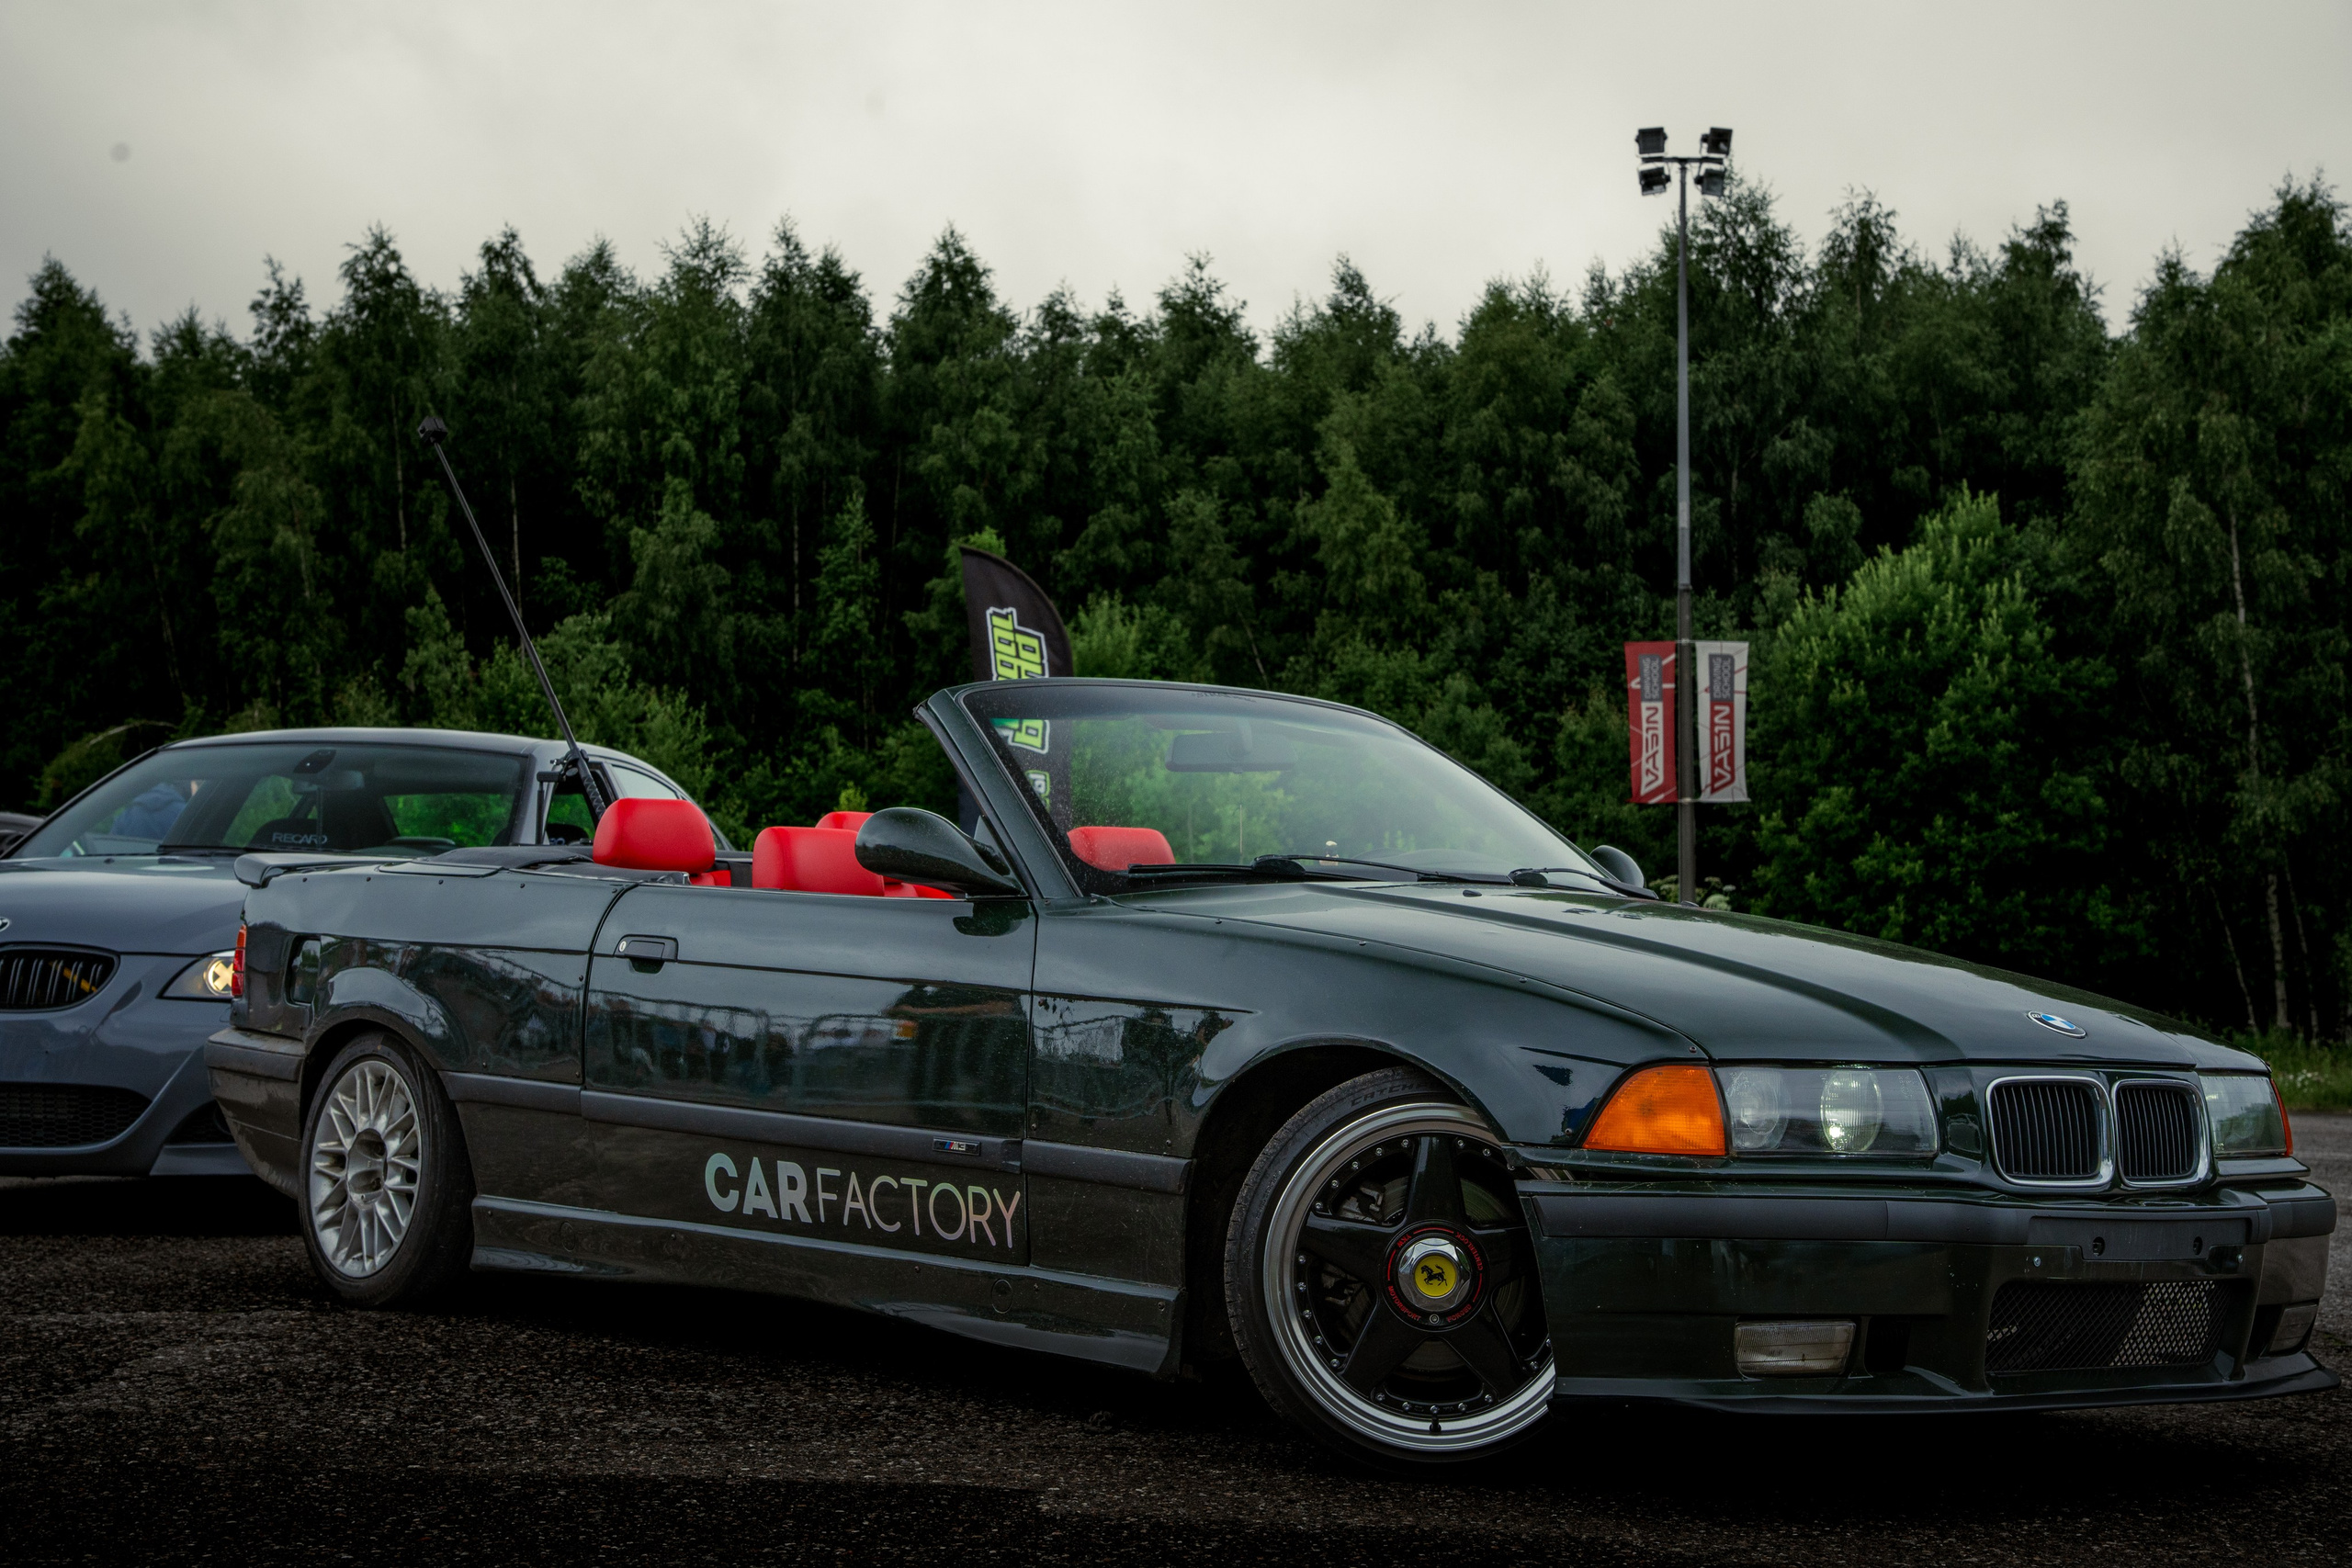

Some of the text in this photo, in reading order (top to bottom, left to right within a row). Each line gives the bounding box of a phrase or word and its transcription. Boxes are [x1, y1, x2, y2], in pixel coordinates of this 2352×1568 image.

[1642, 657, 1651, 700] DRIVING
[1651, 659, 1660, 700] SCHOOL
[1713, 657, 1723, 699] DRIVING
[1723, 659, 1732, 699] SCHOOL
[1645, 705, 1660, 789] VASIN
[1713, 705, 1732, 789] VASIN
[1388, 1286, 1421, 1321] MOTORSPORT
[1447, 1304, 1472, 1322] FORGED
